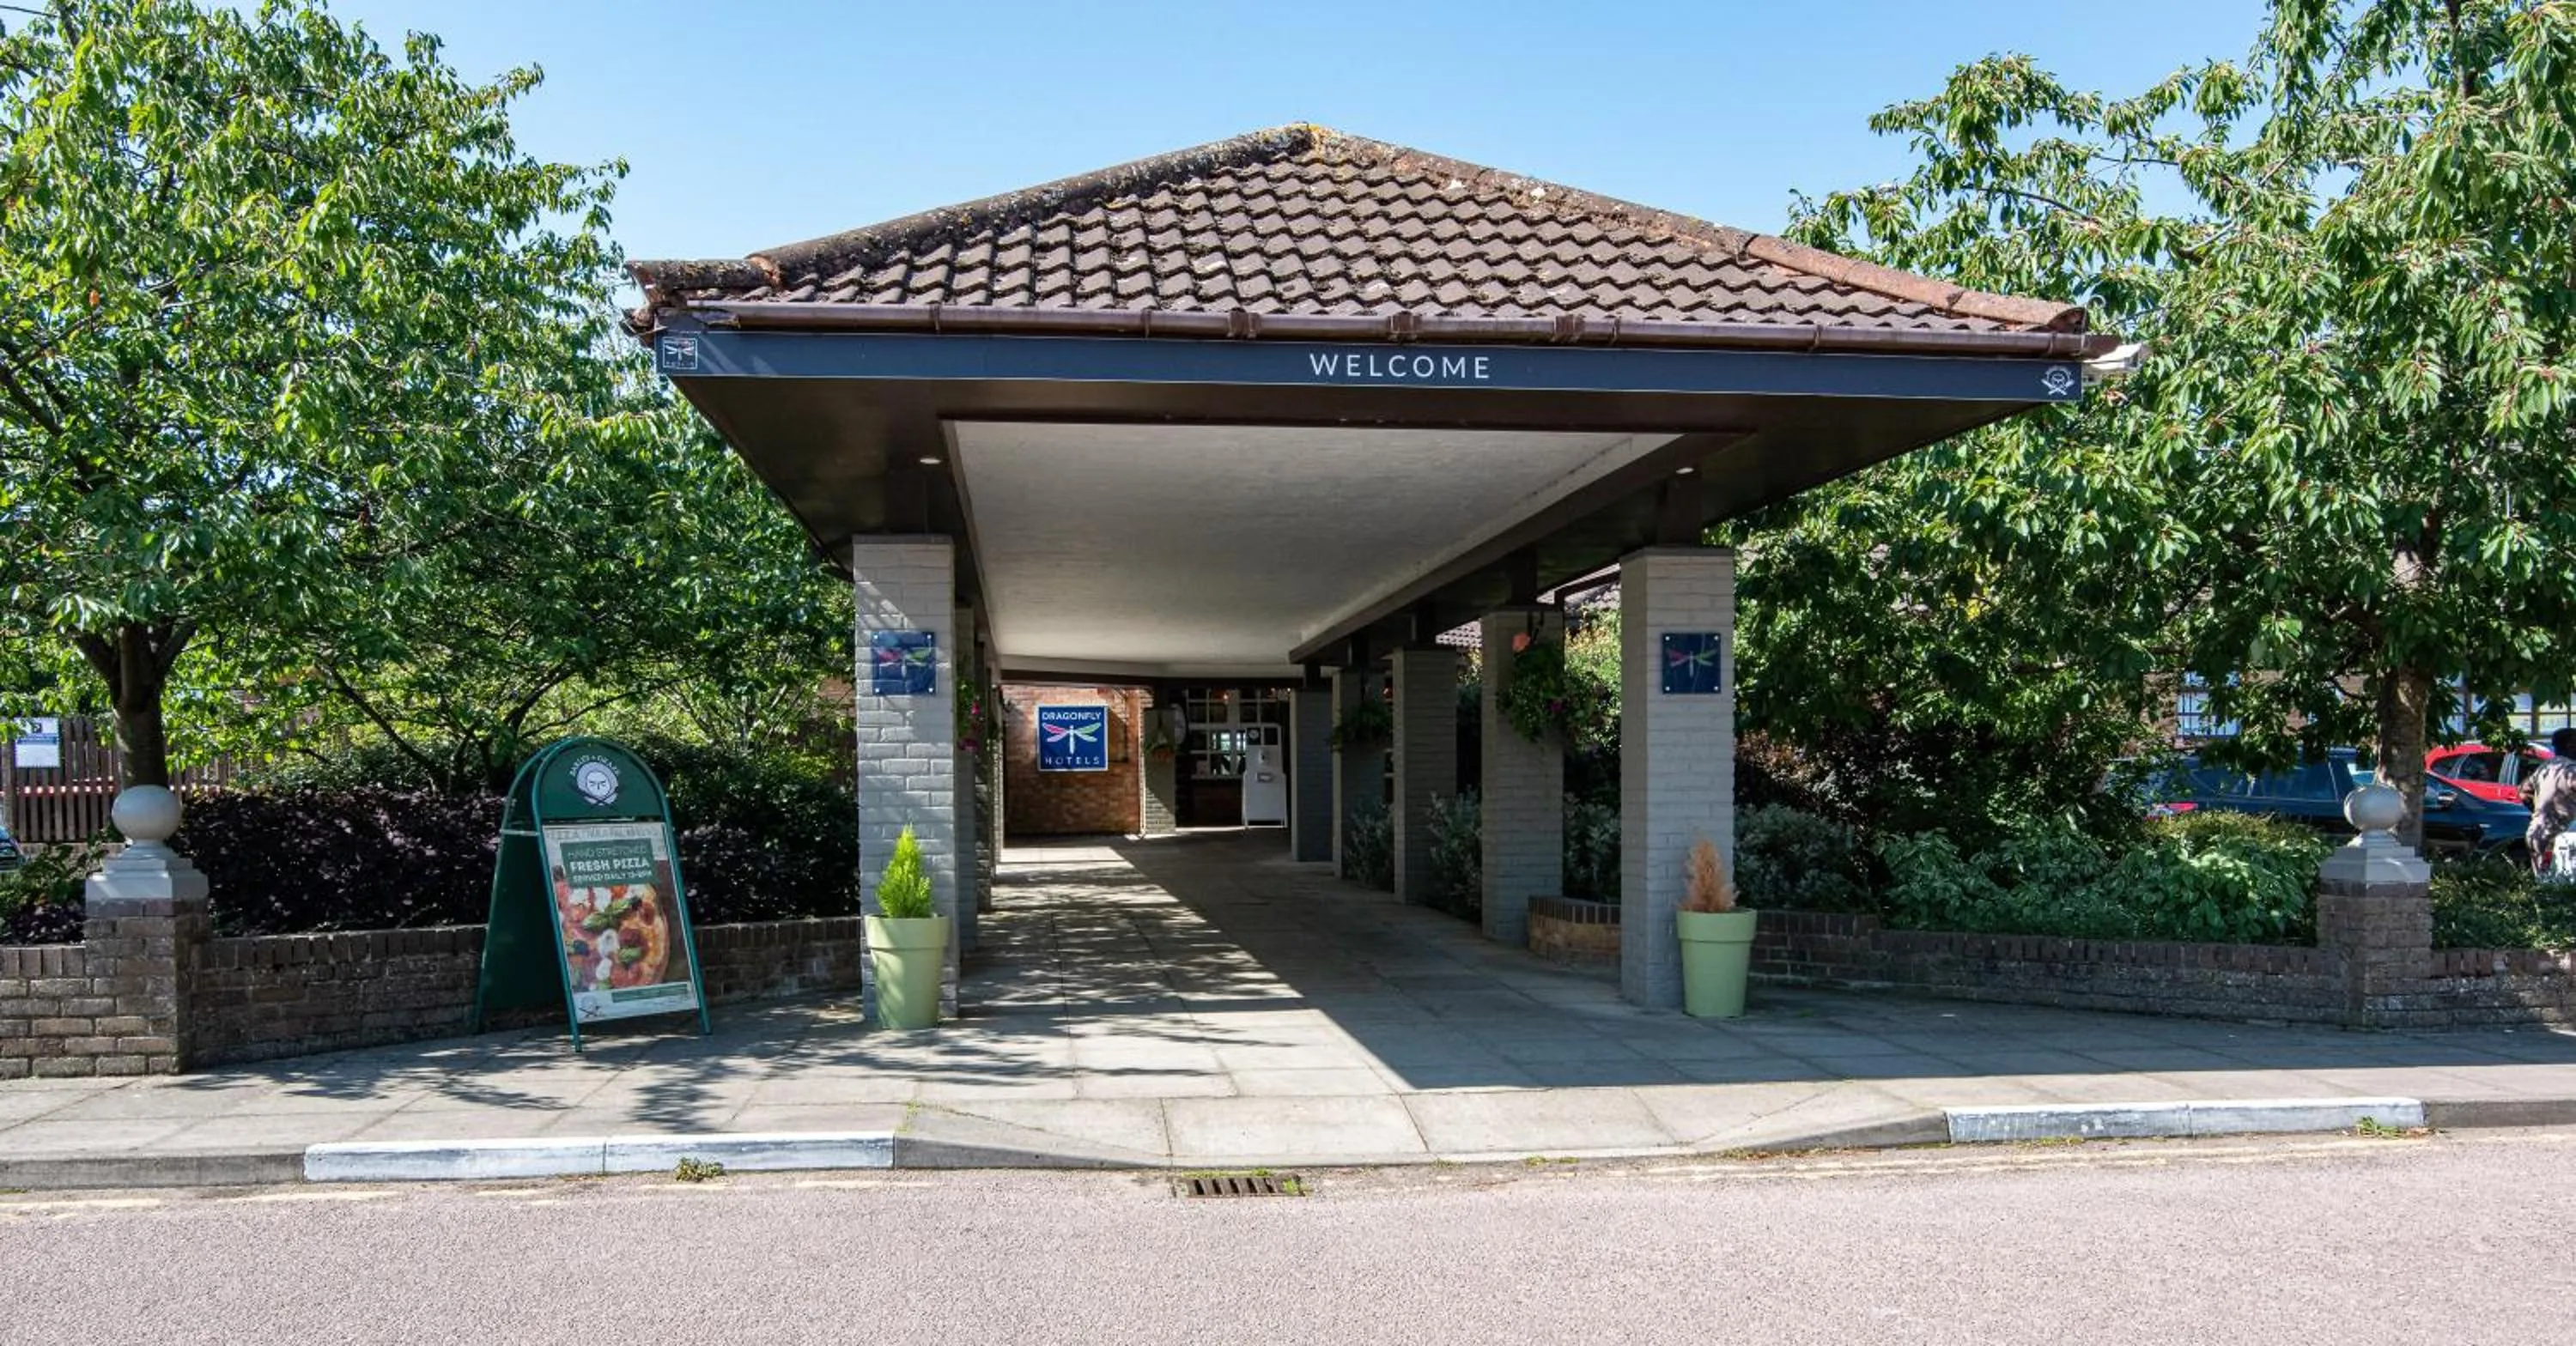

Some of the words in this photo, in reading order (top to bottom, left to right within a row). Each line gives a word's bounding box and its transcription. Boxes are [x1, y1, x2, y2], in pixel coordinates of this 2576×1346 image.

[1309, 353, 1490, 379] WELCOME
[1042, 712, 1102, 720] DRAGONFLY
[1045, 756, 1100, 765] HOTELS
[569, 859, 611, 872] FRESH
[612, 857, 650, 870] PIZZA
